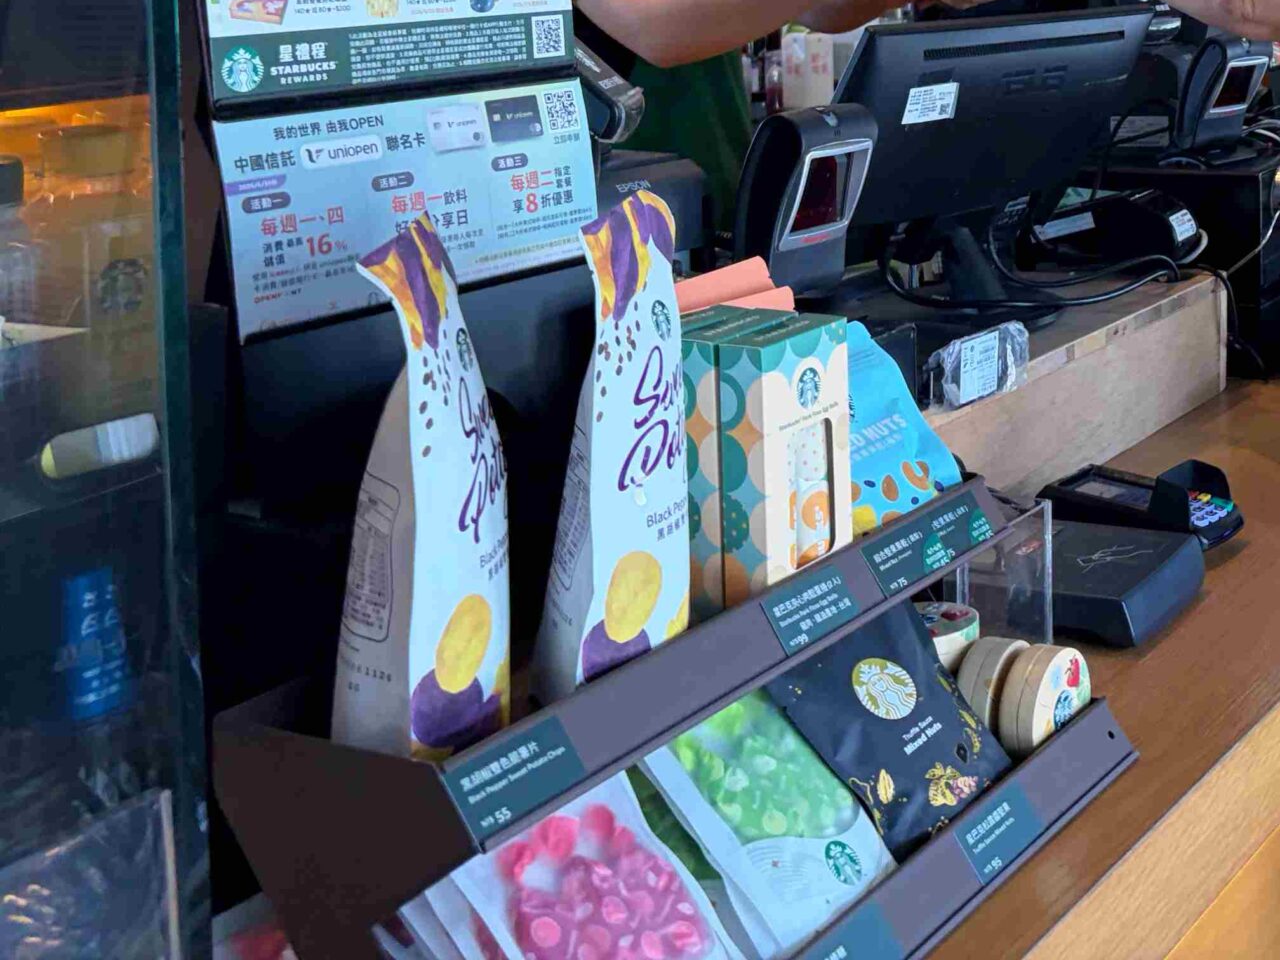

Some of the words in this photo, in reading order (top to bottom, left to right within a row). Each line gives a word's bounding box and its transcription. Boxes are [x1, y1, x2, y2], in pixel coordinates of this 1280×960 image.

[279, 42, 328, 63] 星禮程
[270, 61, 336, 76] STARBUCKS
[279, 73, 328, 85] REWARDS
[273, 121, 321, 140] 我的世界
[326, 115, 384, 134] 由我OPEN
[234, 150, 296, 173] 中國信託
[328, 142, 378, 161] uniopen
[385, 132, 425, 152] 聯名卡
[498, 155, 522, 168] 活動三
[380, 176, 408, 188] 活動二
[510, 169, 554, 191] 每週二
[554, 165, 571, 177] 指定
[250, 197, 283, 211] 活動一
[513, 190, 574, 214] 享8折優惠
[261, 206, 344, 237] 每週一、四
[263, 240, 284, 254] 消費
[264, 256, 285, 267] 儲值
[862, 413, 907, 440] NUTS
[646, 506, 672, 528] Black
[902, 726, 920, 741] Truffle
[903, 733, 928, 755] Mixed
[925, 722, 942, 738] Nuts
[467, 790, 487, 805] Black
[485, 778, 509, 794] Pepper
[508, 767, 529, 782] Sweet
[526, 756, 548, 770] Potato
[547, 746, 566, 759] Chips
[494, 806, 512, 824] 55
[991, 856, 1002, 870] 95
